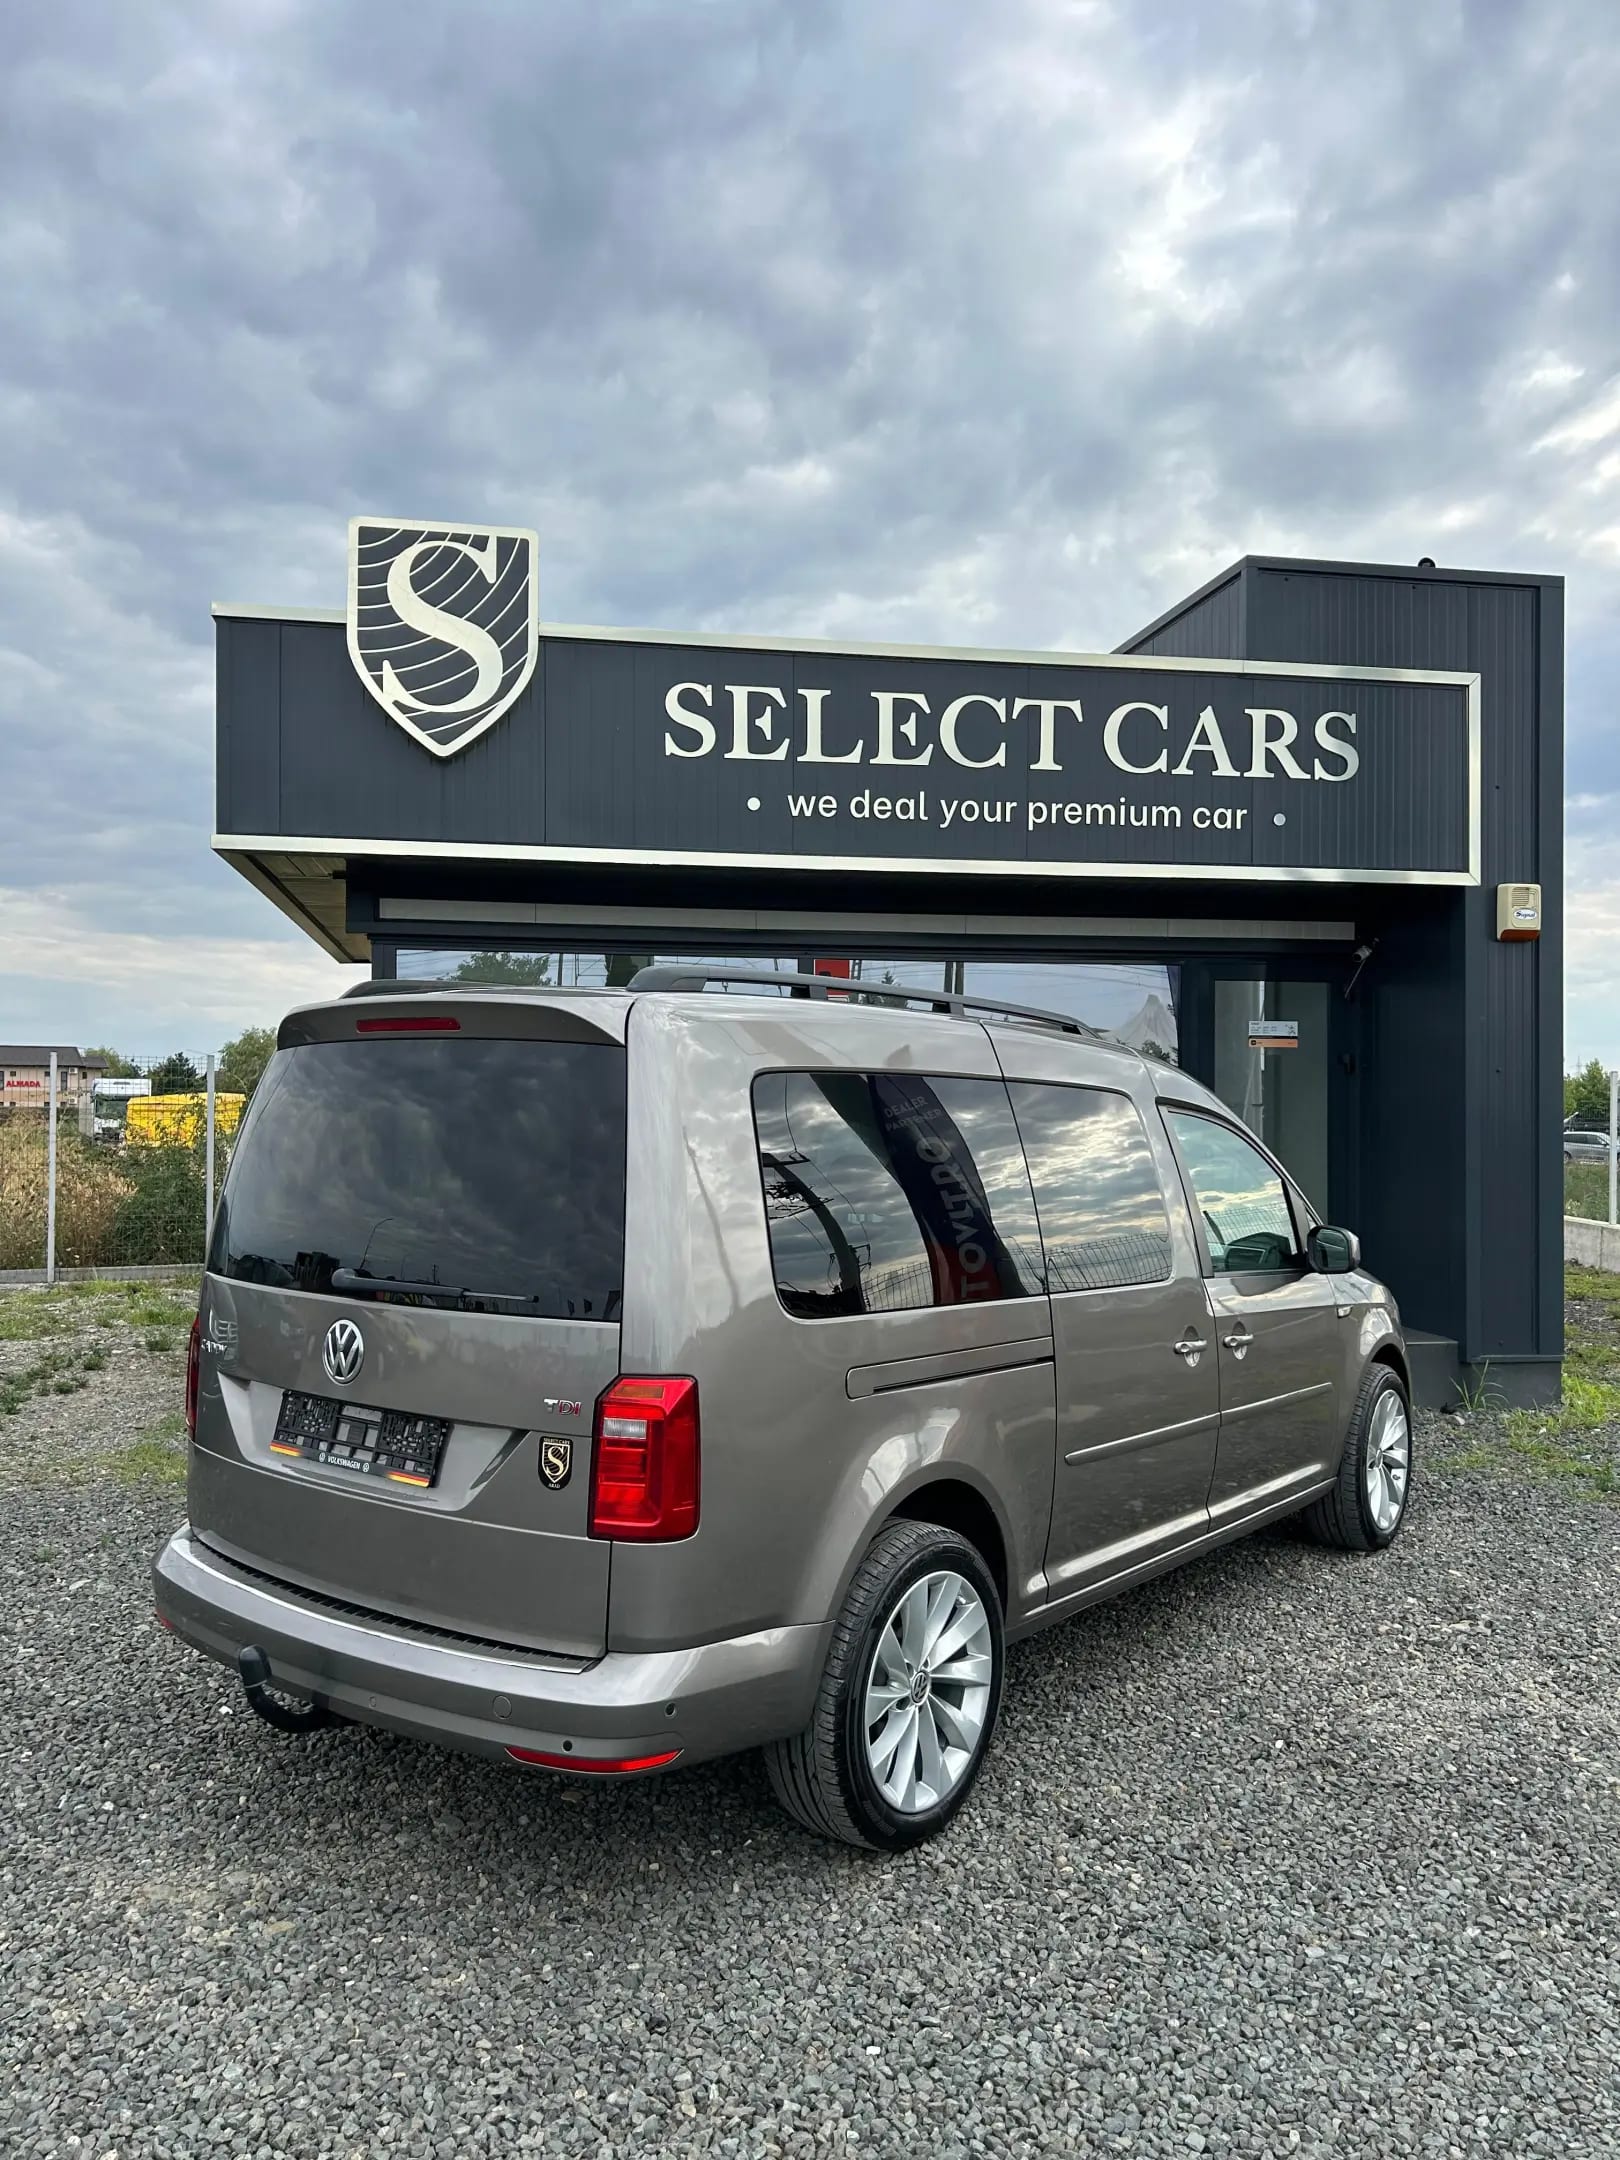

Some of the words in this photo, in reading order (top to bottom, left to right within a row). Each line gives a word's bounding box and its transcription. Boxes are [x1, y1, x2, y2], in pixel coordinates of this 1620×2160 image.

[386, 535, 503, 713] S
[664, 682, 1083, 770] SELECT
[1103, 702, 1360, 782] CARS
[787, 794, 838, 817] we
[849, 789, 929, 821] deal
[939, 799, 1018, 829] your
[1028, 796, 1182, 831] premium
[1192, 806, 1249, 830] car
[883, 1095, 929, 1118] DEALER
[543, 1398, 582, 1416] TDI
[327, 1455, 361, 1470] VOLKSWAGEN
